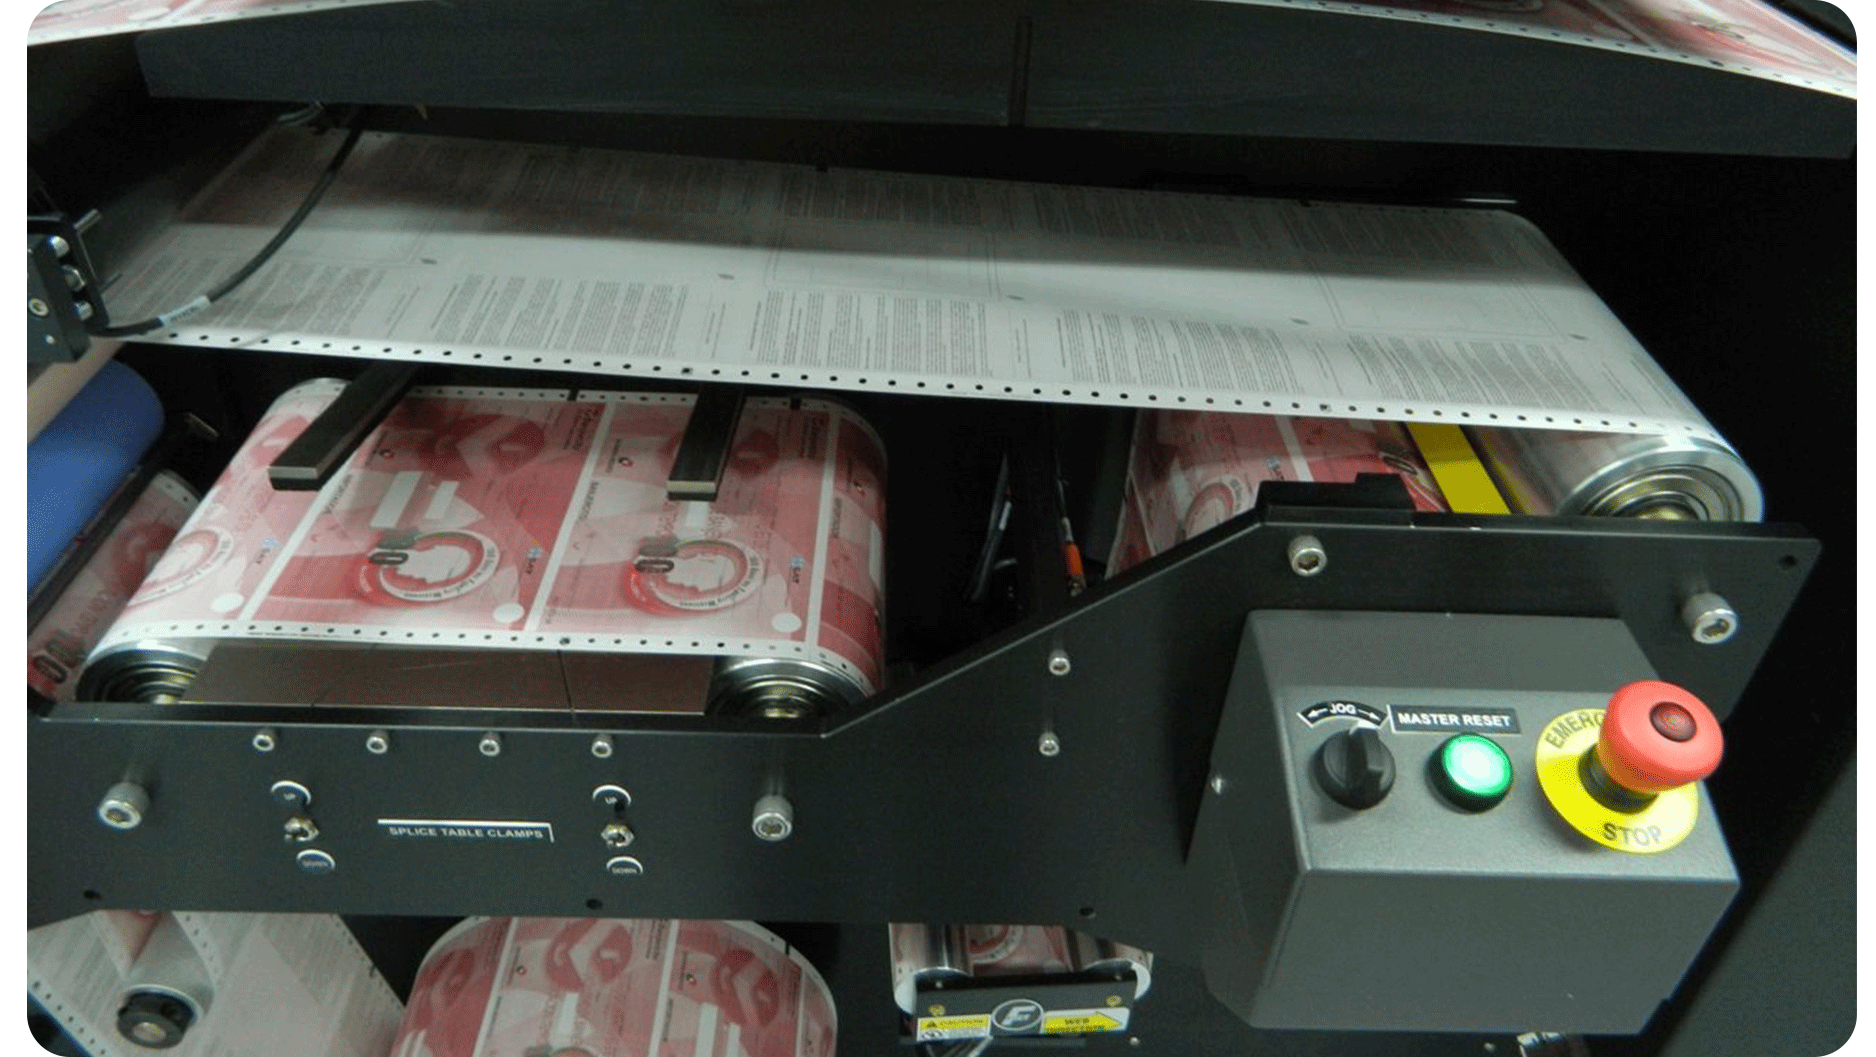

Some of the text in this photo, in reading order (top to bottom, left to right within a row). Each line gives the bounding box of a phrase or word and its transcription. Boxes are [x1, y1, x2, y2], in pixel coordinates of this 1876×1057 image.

[1329, 702, 1358, 715] JOG
[1397, 712, 1511, 727] MASTER RESET
[389, 826, 544, 839] SPLICE TABLE CLAMPS
[1602, 822, 1662, 847] STOP
